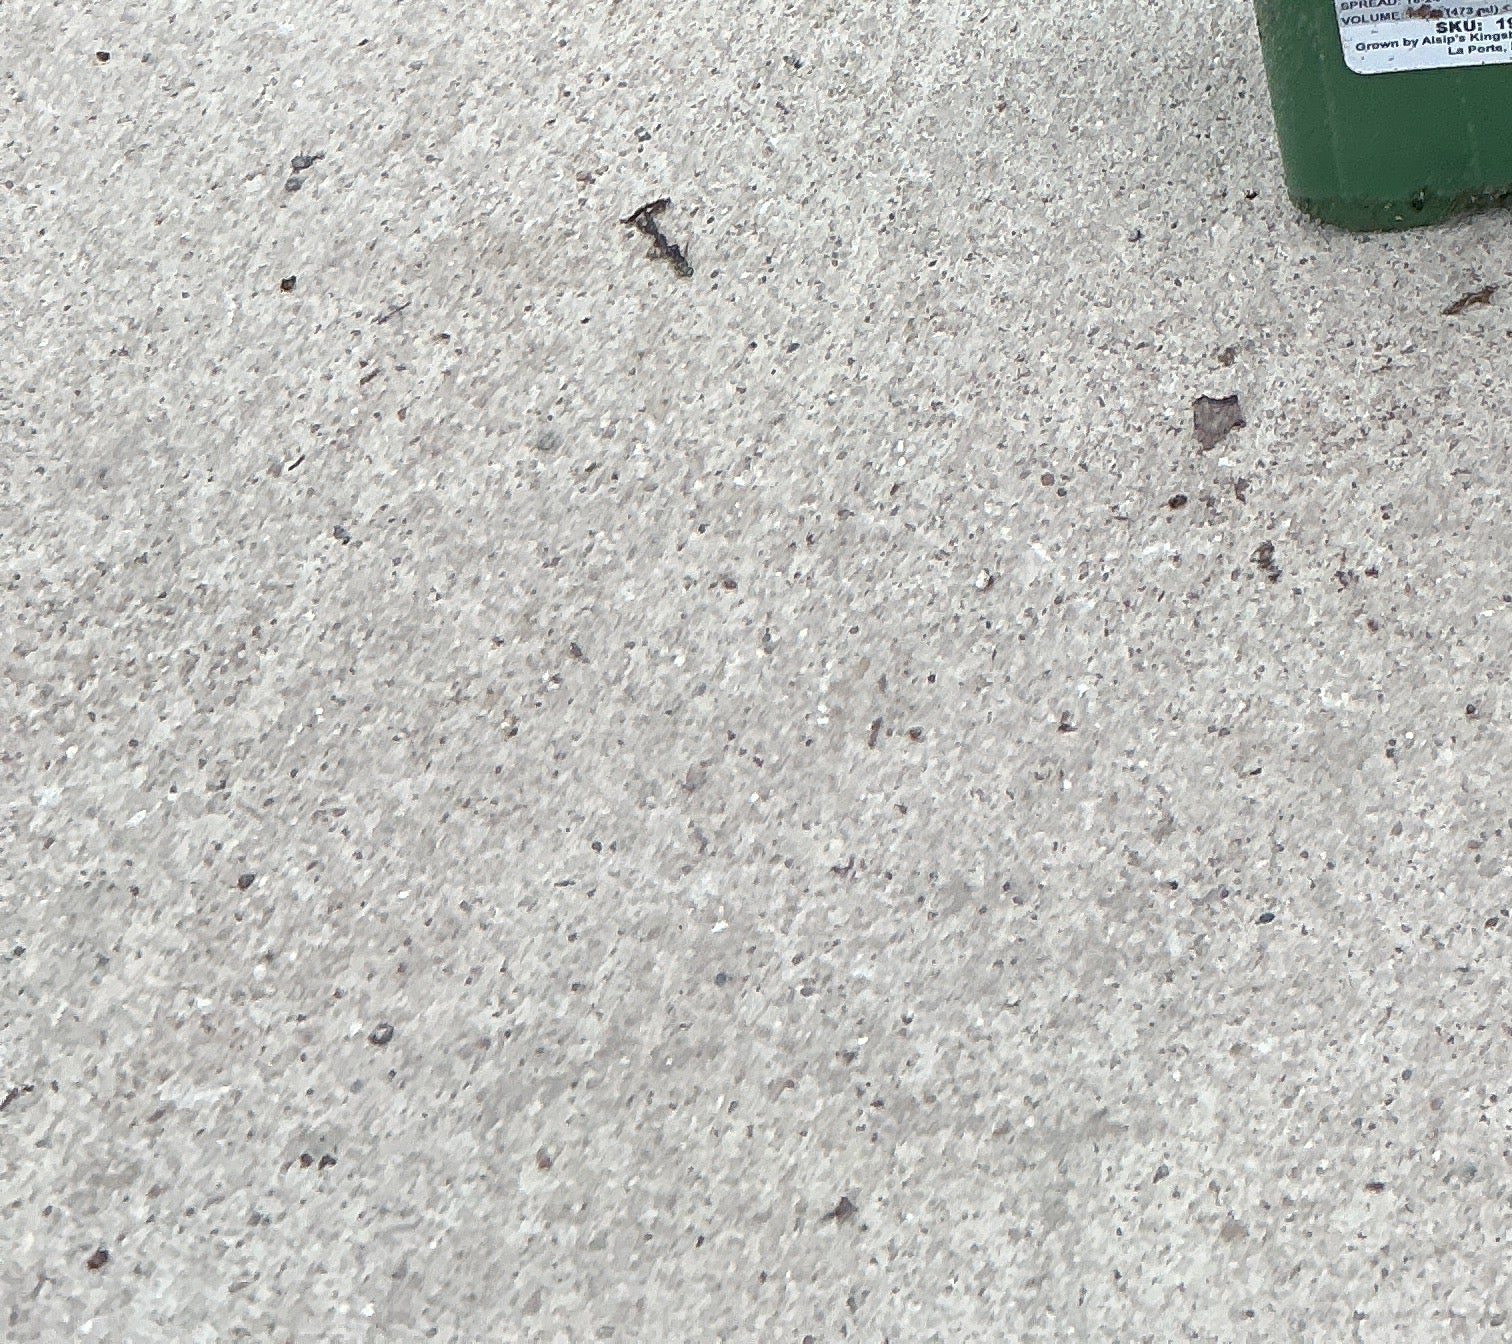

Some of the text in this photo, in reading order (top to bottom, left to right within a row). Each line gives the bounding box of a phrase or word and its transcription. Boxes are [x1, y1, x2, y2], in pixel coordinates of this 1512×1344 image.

[1435, 20, 1483, 34] SKU:
[1355, 40, 1399, 52] Grown
[1402, 37, 1419, 49] by
[1448, 46, 1464, 56] La
